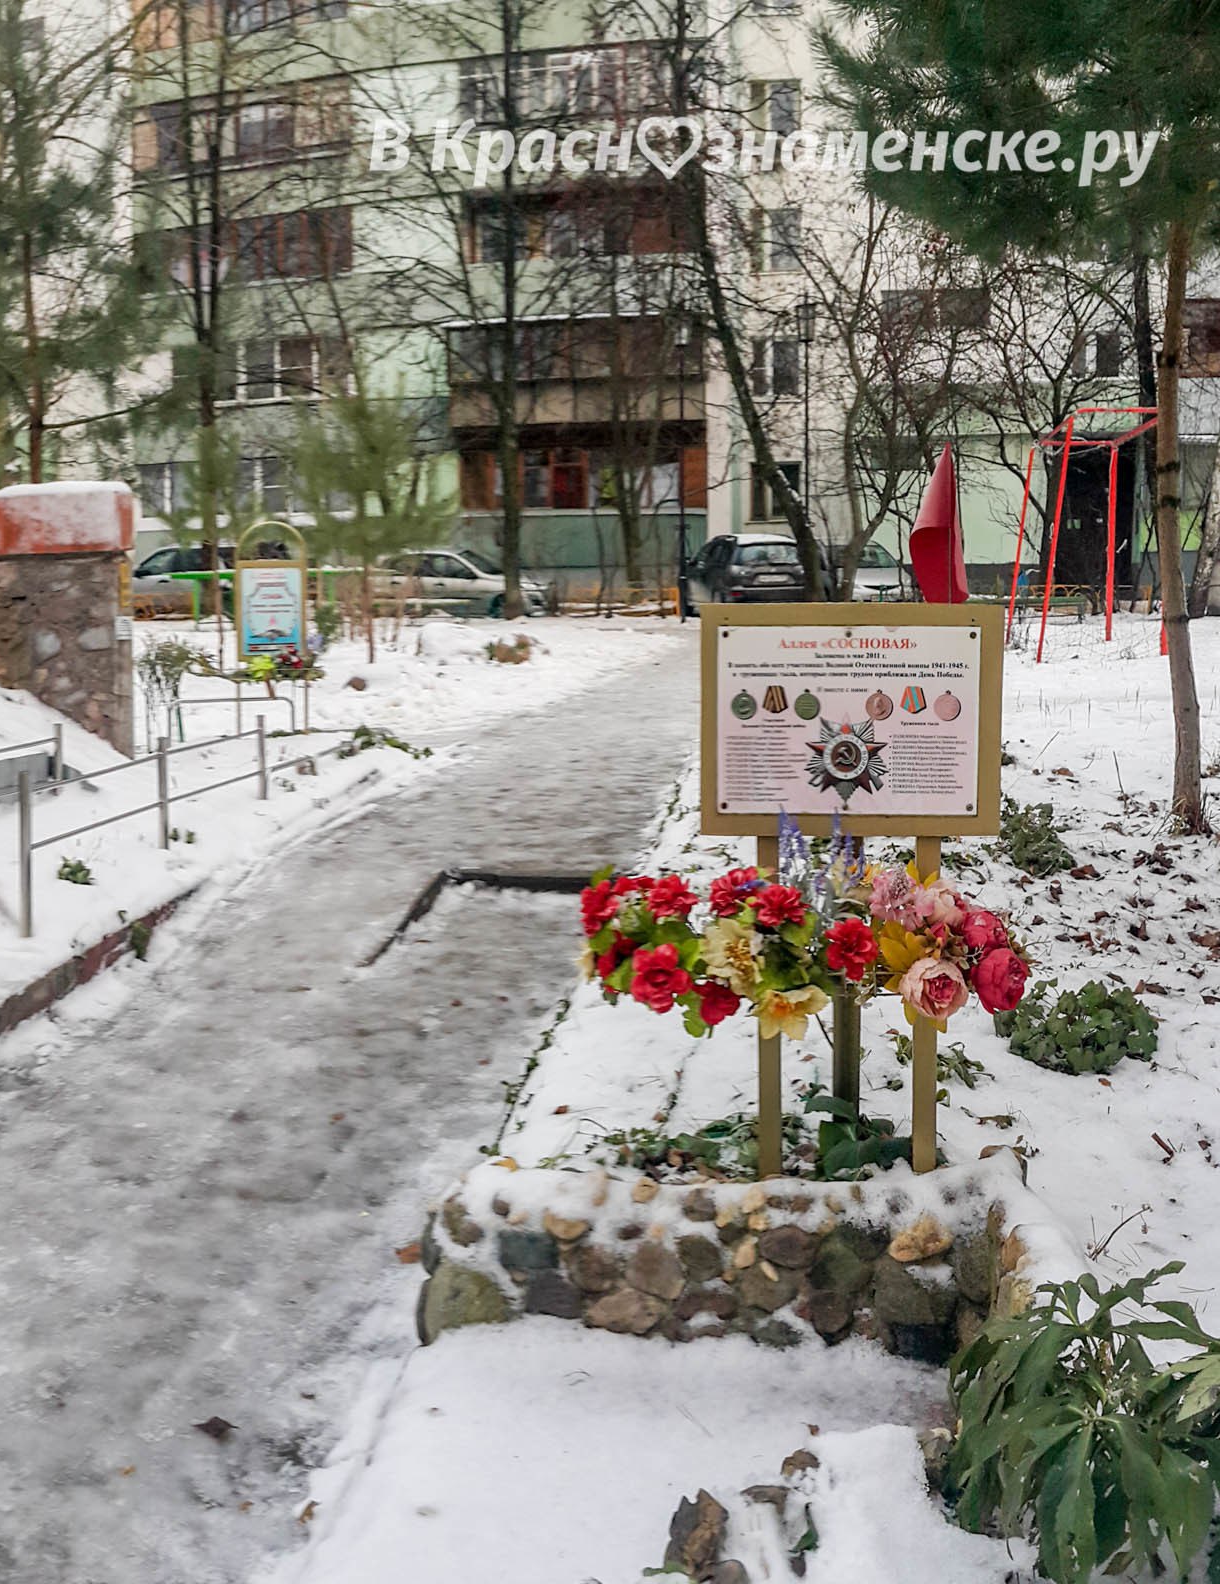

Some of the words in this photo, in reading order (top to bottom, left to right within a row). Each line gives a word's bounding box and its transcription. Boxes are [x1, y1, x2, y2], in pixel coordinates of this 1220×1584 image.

[780, 638, 817, 649] Аллея
[821, 637, 918, 650] «СОСНОВАЯ»
[875, 670, 917, 679] приближали
[936, 671, 965, 679] Победы.
